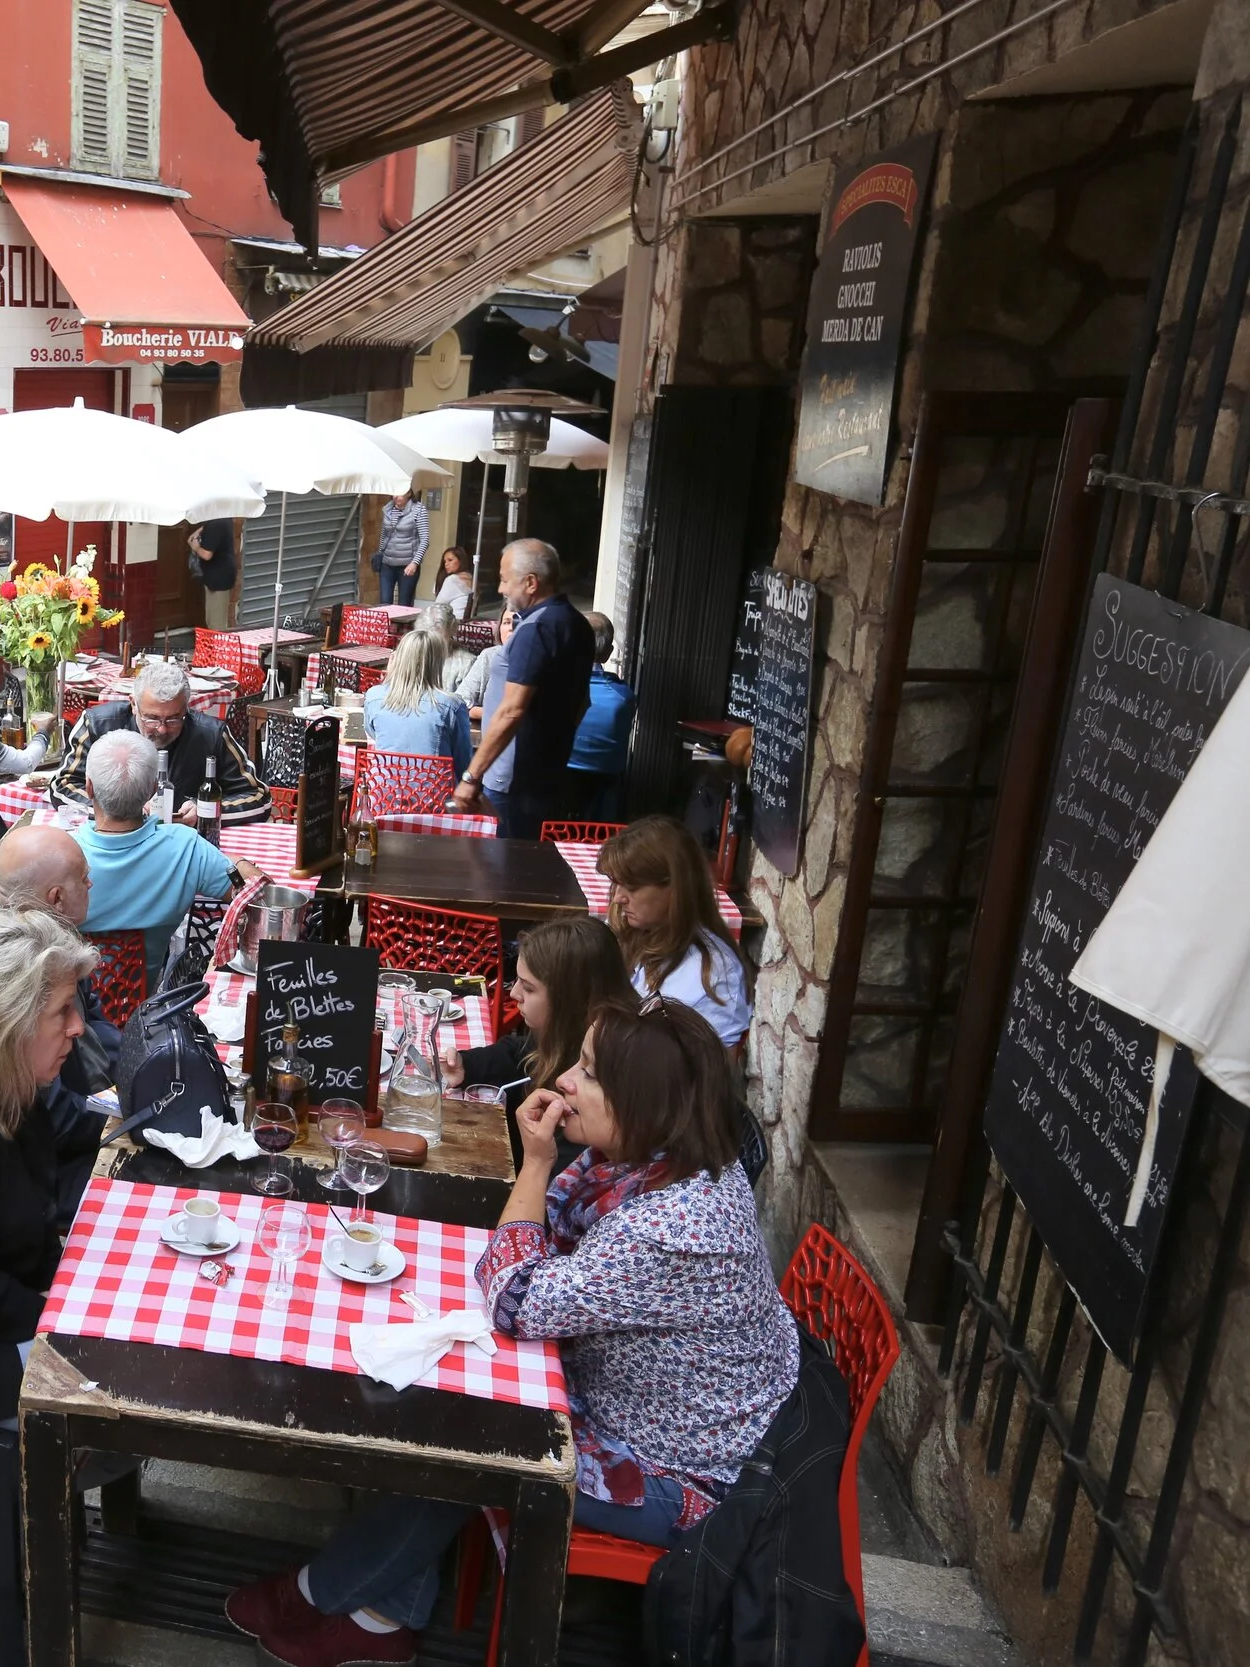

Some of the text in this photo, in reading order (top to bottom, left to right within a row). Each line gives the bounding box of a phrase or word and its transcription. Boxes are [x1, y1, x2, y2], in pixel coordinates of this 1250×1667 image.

[842, 242, 883, 272] RAVIOLIS
[837, 281, 877, 309] GNOCCHI
[46, 316, 83, 333] Via
[101, 328, 183, 347] Boucherie
[821, 316, 883, 342] MERDA DE CAN
[30, 348, 84, 363] 93.80.5
[140, 349, 205, 357] 04 93 80 50 35
[262, 956, 339, 993] Feuilles
[264, 991, 356, 1021] de Blettes
[260, 1024, 335, 1053] Facies
[304, 1063, 364, 1090] 2,50€
